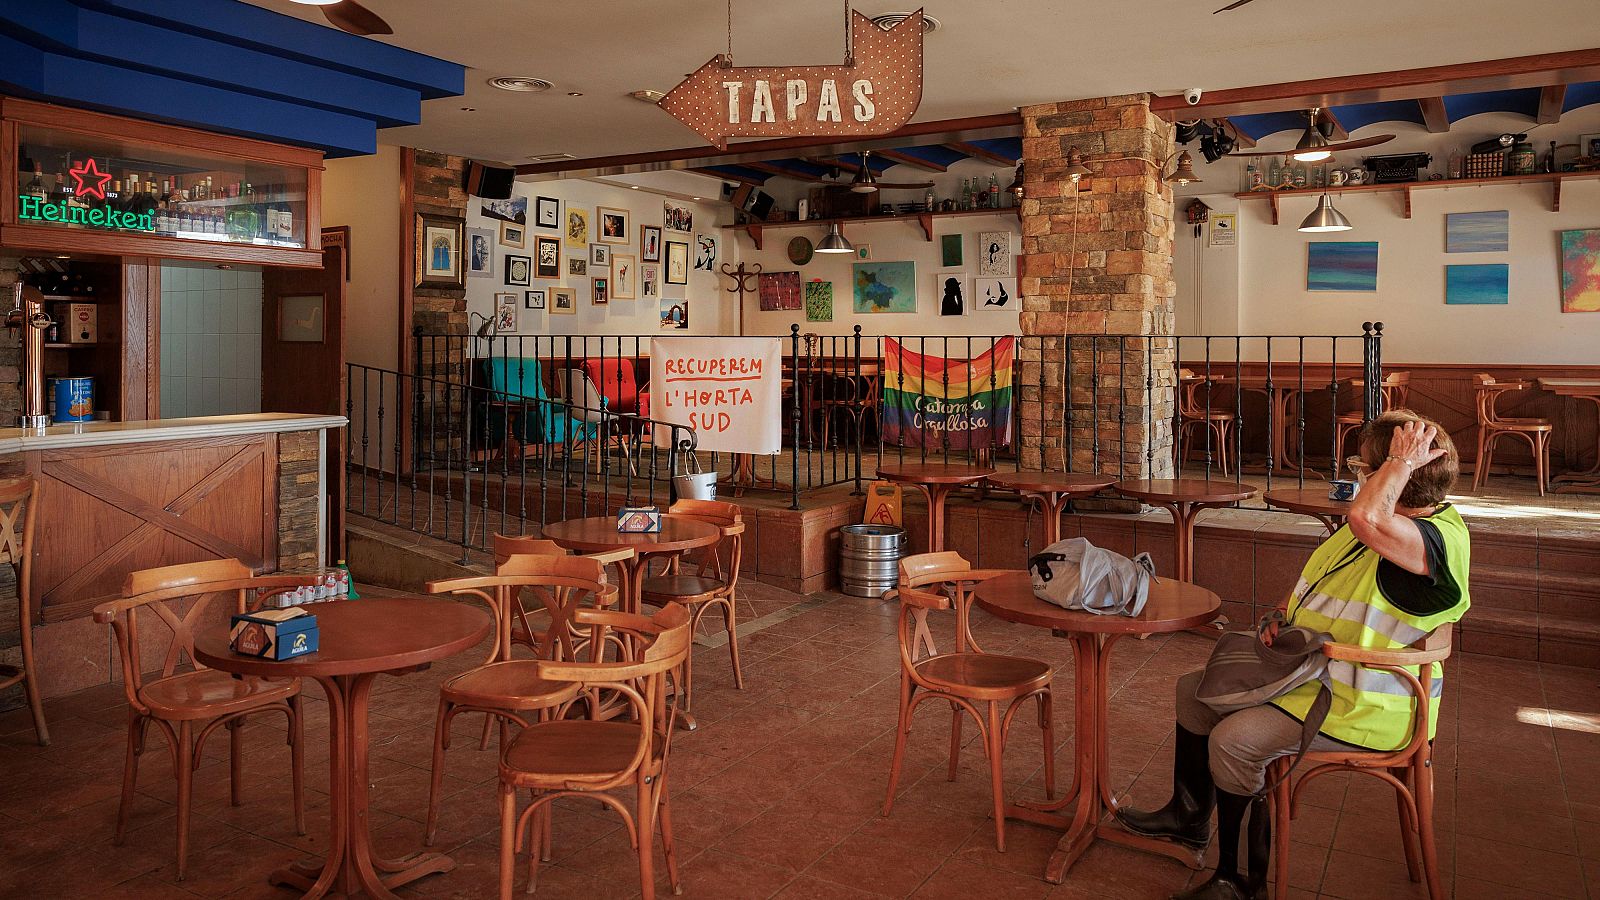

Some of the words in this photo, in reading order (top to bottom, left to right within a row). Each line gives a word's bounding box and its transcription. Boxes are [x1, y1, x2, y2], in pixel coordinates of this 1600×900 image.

[722, 79, 876, 123] TAPAS
[18, 195, 154, 231] Heineken
[665, 358, 762, 376] RECUPEREM
[665, 387, 753, 408] L'HORTA
[688, 412, 731, 433] SUD
